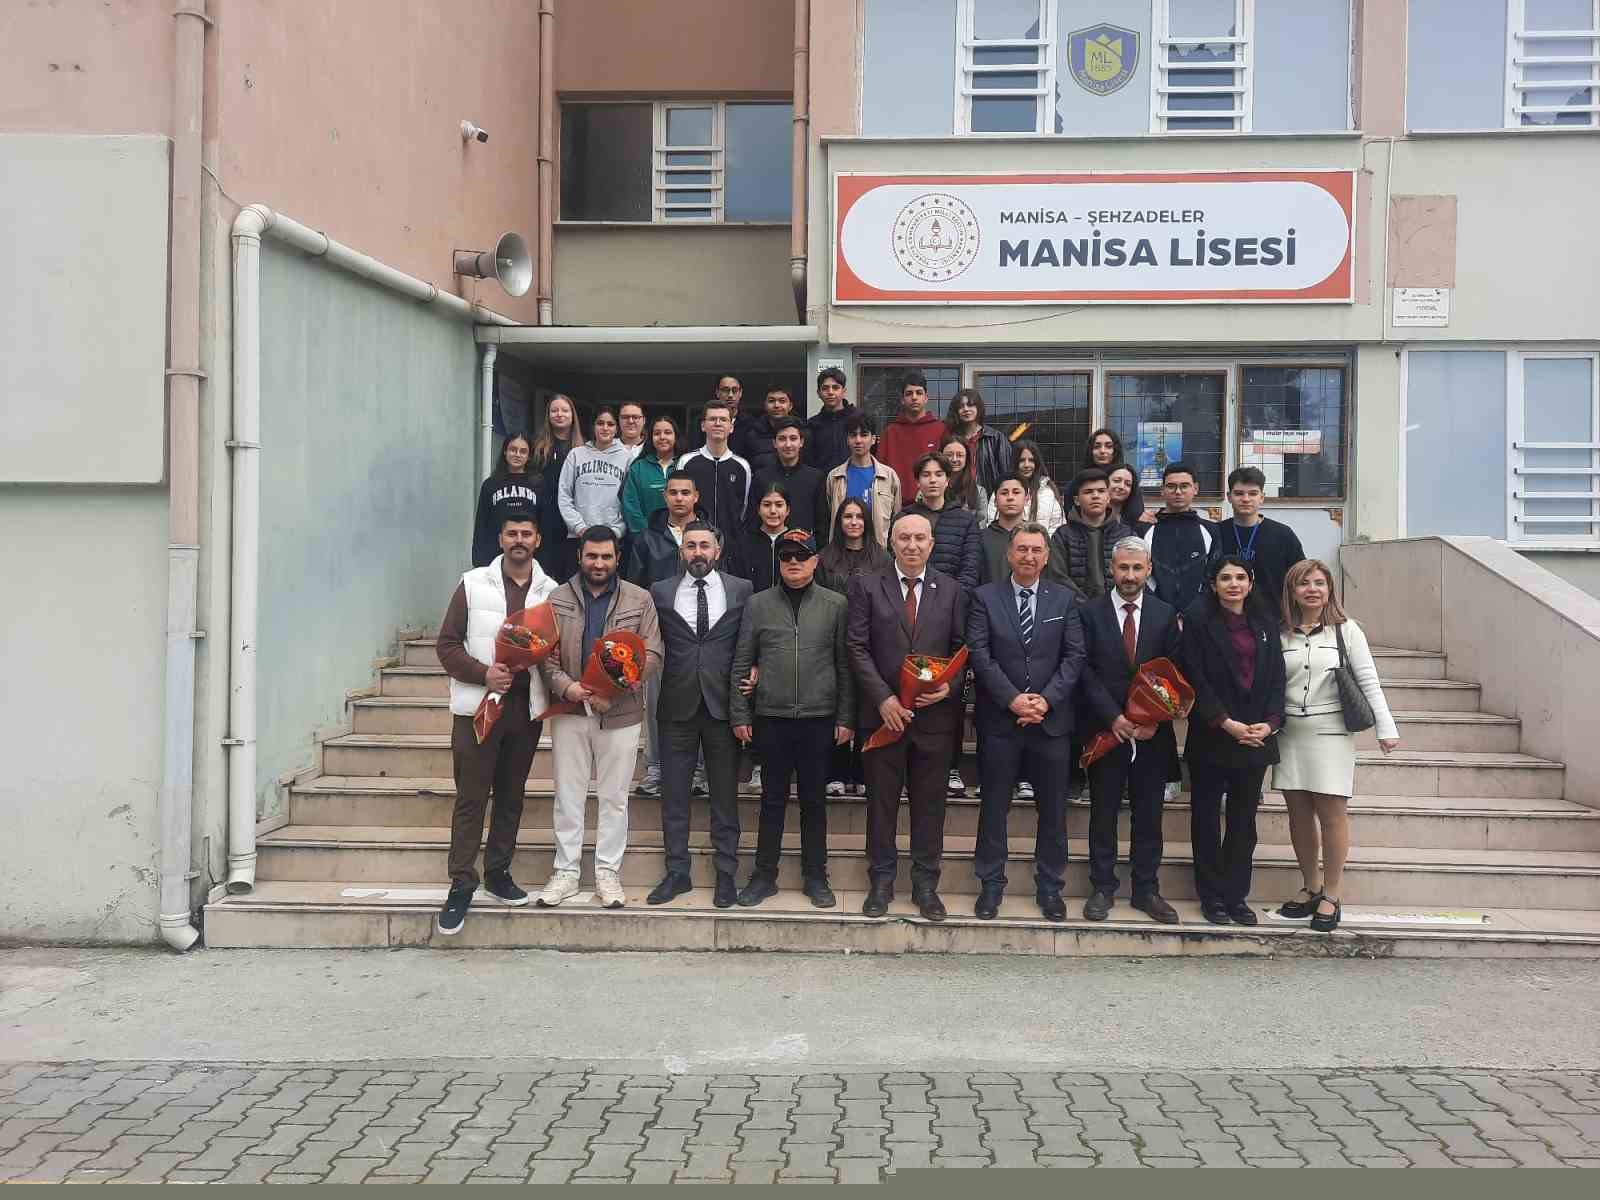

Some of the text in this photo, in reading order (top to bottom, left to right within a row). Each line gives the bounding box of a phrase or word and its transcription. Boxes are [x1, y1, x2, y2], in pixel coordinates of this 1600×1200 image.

[1090, 51, 1113, 64] ML
[1000, 208, 1068, 224] MANİSA
[1087, 210, 1205, 227] ŞEHZADELER
[999, 229, 1159, 267] MANİSA
[1169, 228, 1296, 267] LİSESİ
